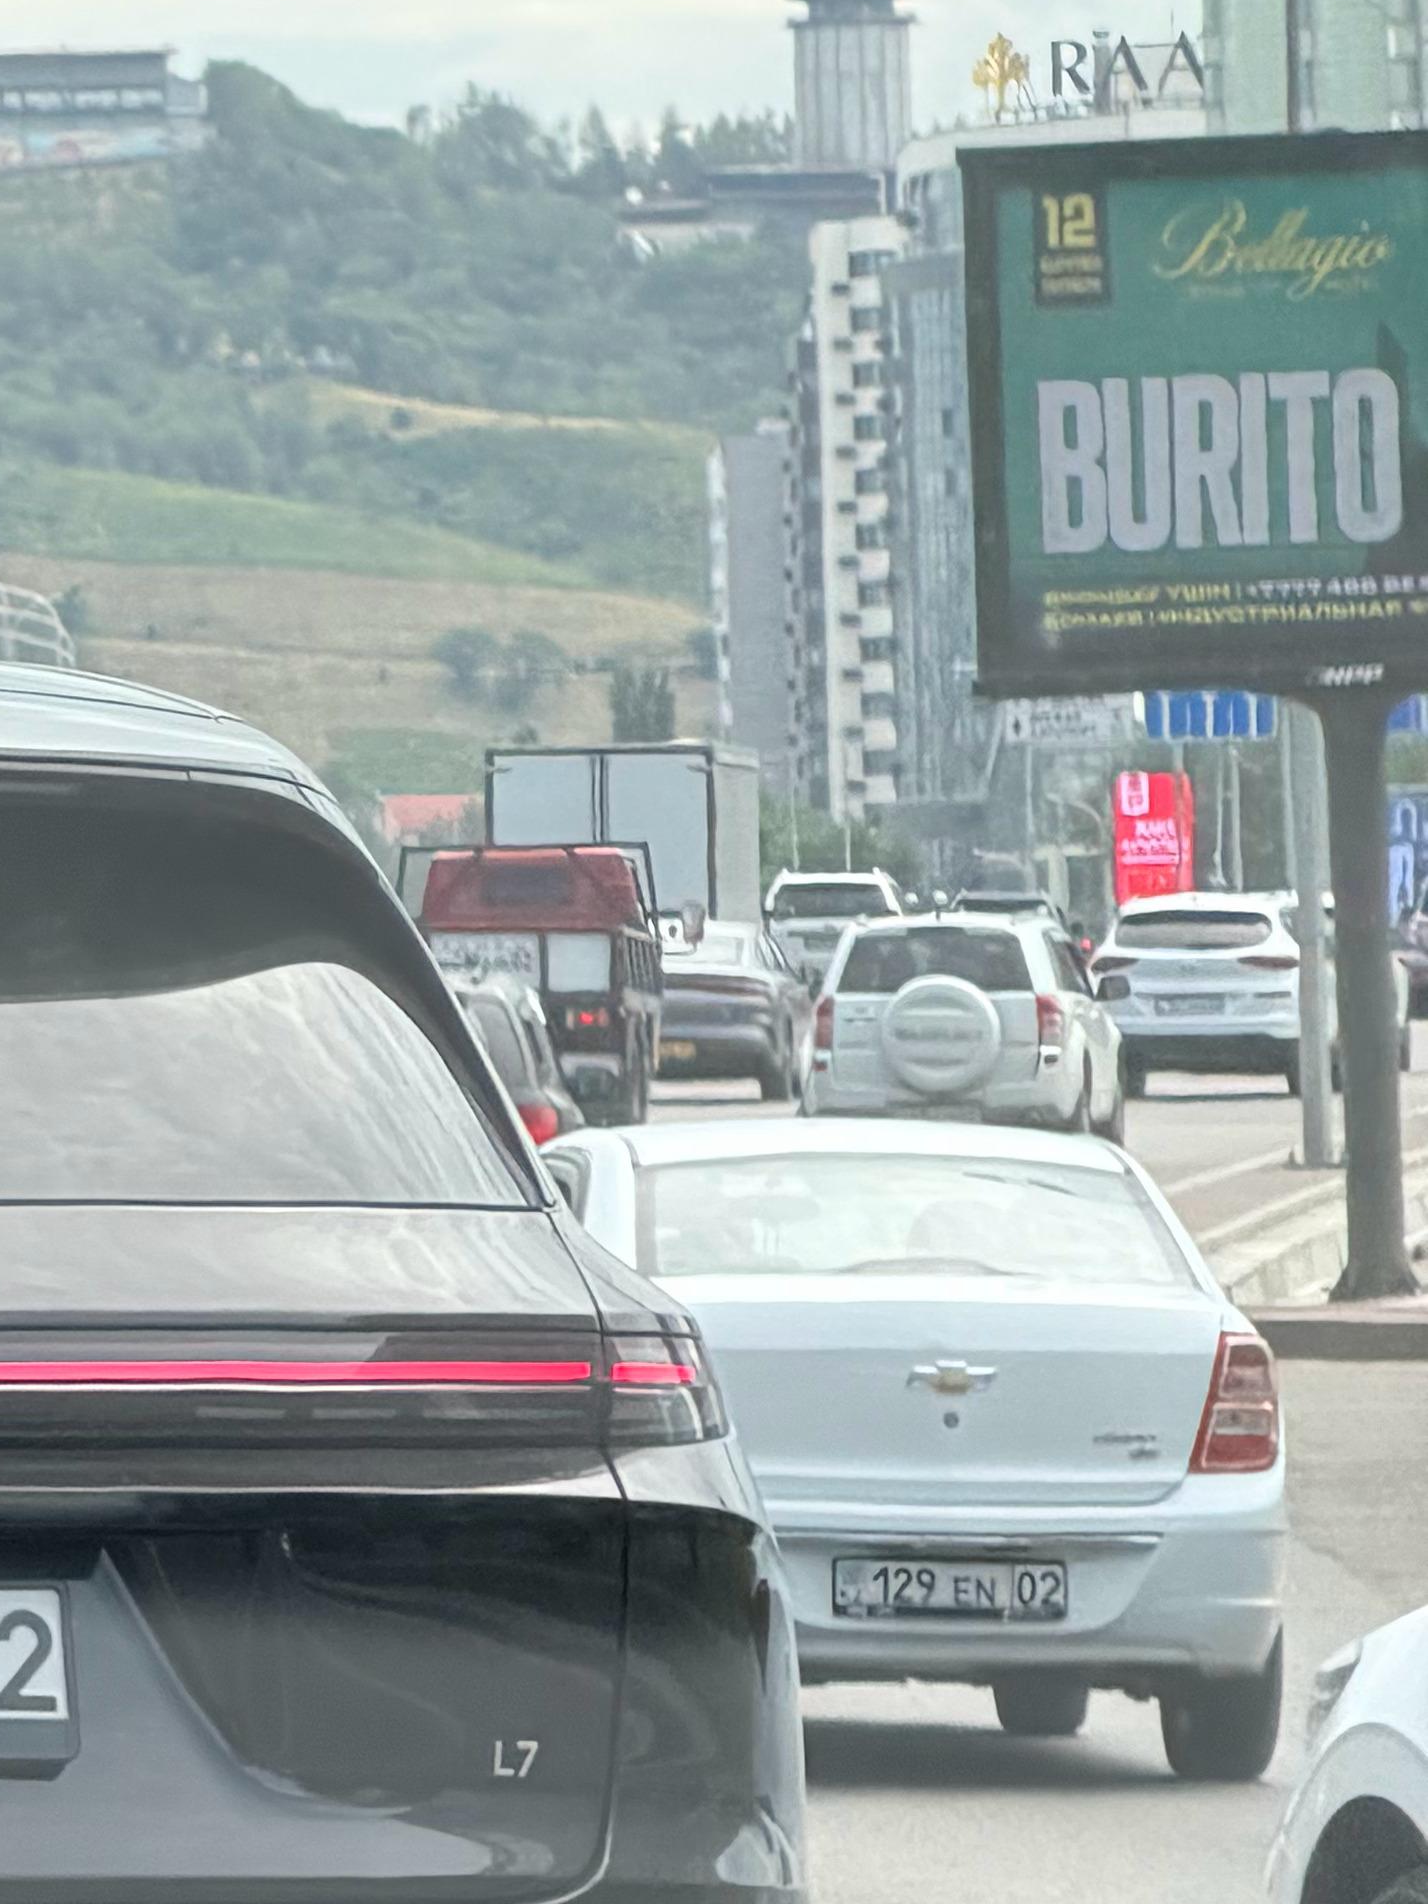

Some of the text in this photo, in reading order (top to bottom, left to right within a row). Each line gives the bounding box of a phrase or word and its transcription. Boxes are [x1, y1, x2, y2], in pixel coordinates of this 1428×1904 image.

[1042, 193, 1096, 249] 12
[1038, 368, 1402, 554] BURITO
[872, 1566, 936, 1606] 129
[1017, 1571, 1061, 1606] 02
[494, 1740, 539, 1777] L7
